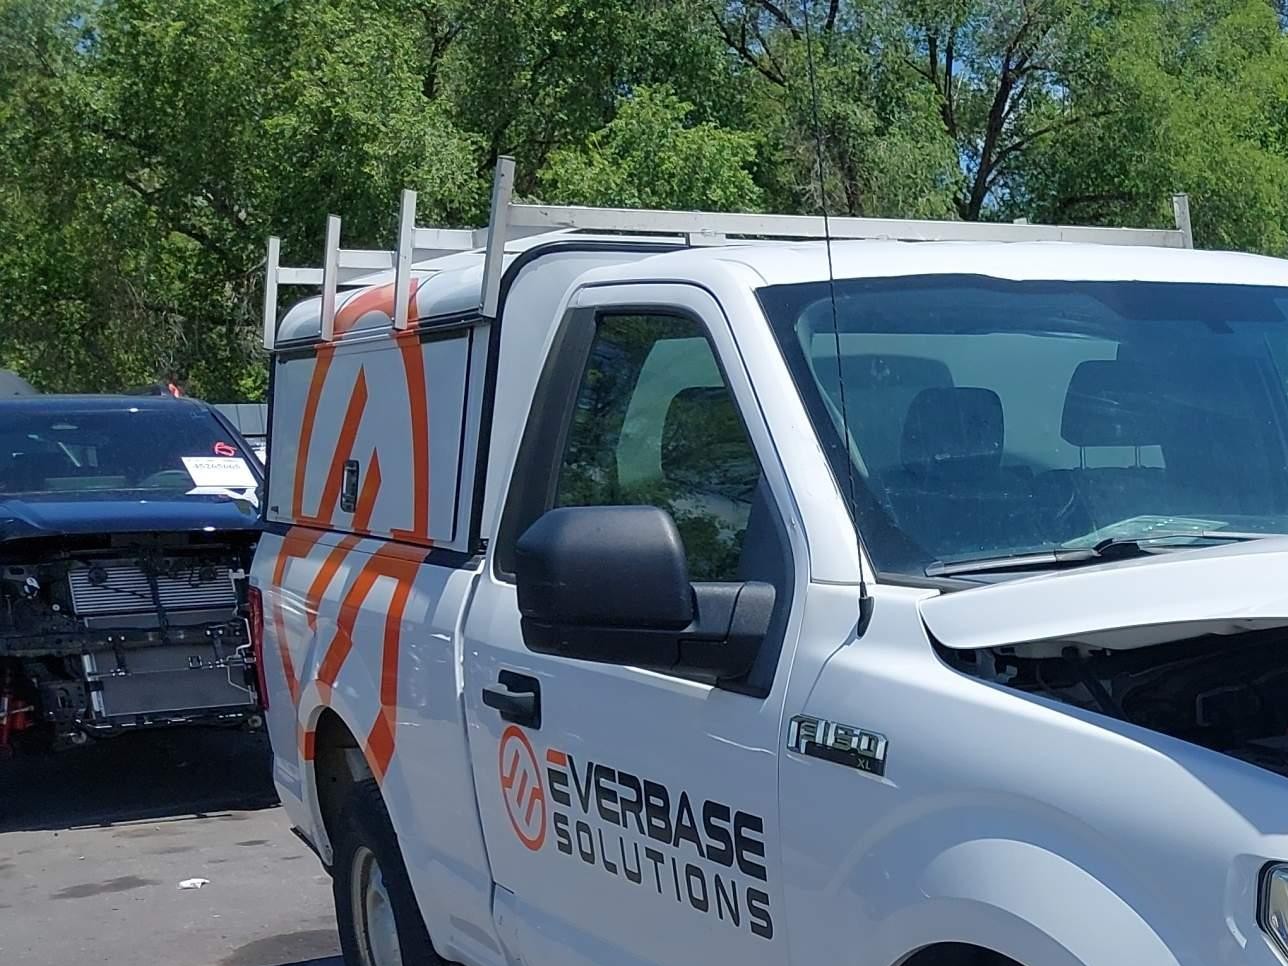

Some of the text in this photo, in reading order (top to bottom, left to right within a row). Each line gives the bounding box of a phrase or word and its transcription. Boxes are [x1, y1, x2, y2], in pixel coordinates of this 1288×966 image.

[546, 749, 767, 882] EVERBASE
[857, 758, 872, 771] XL
[553, 811, 774, 940] SOLUTIONS
